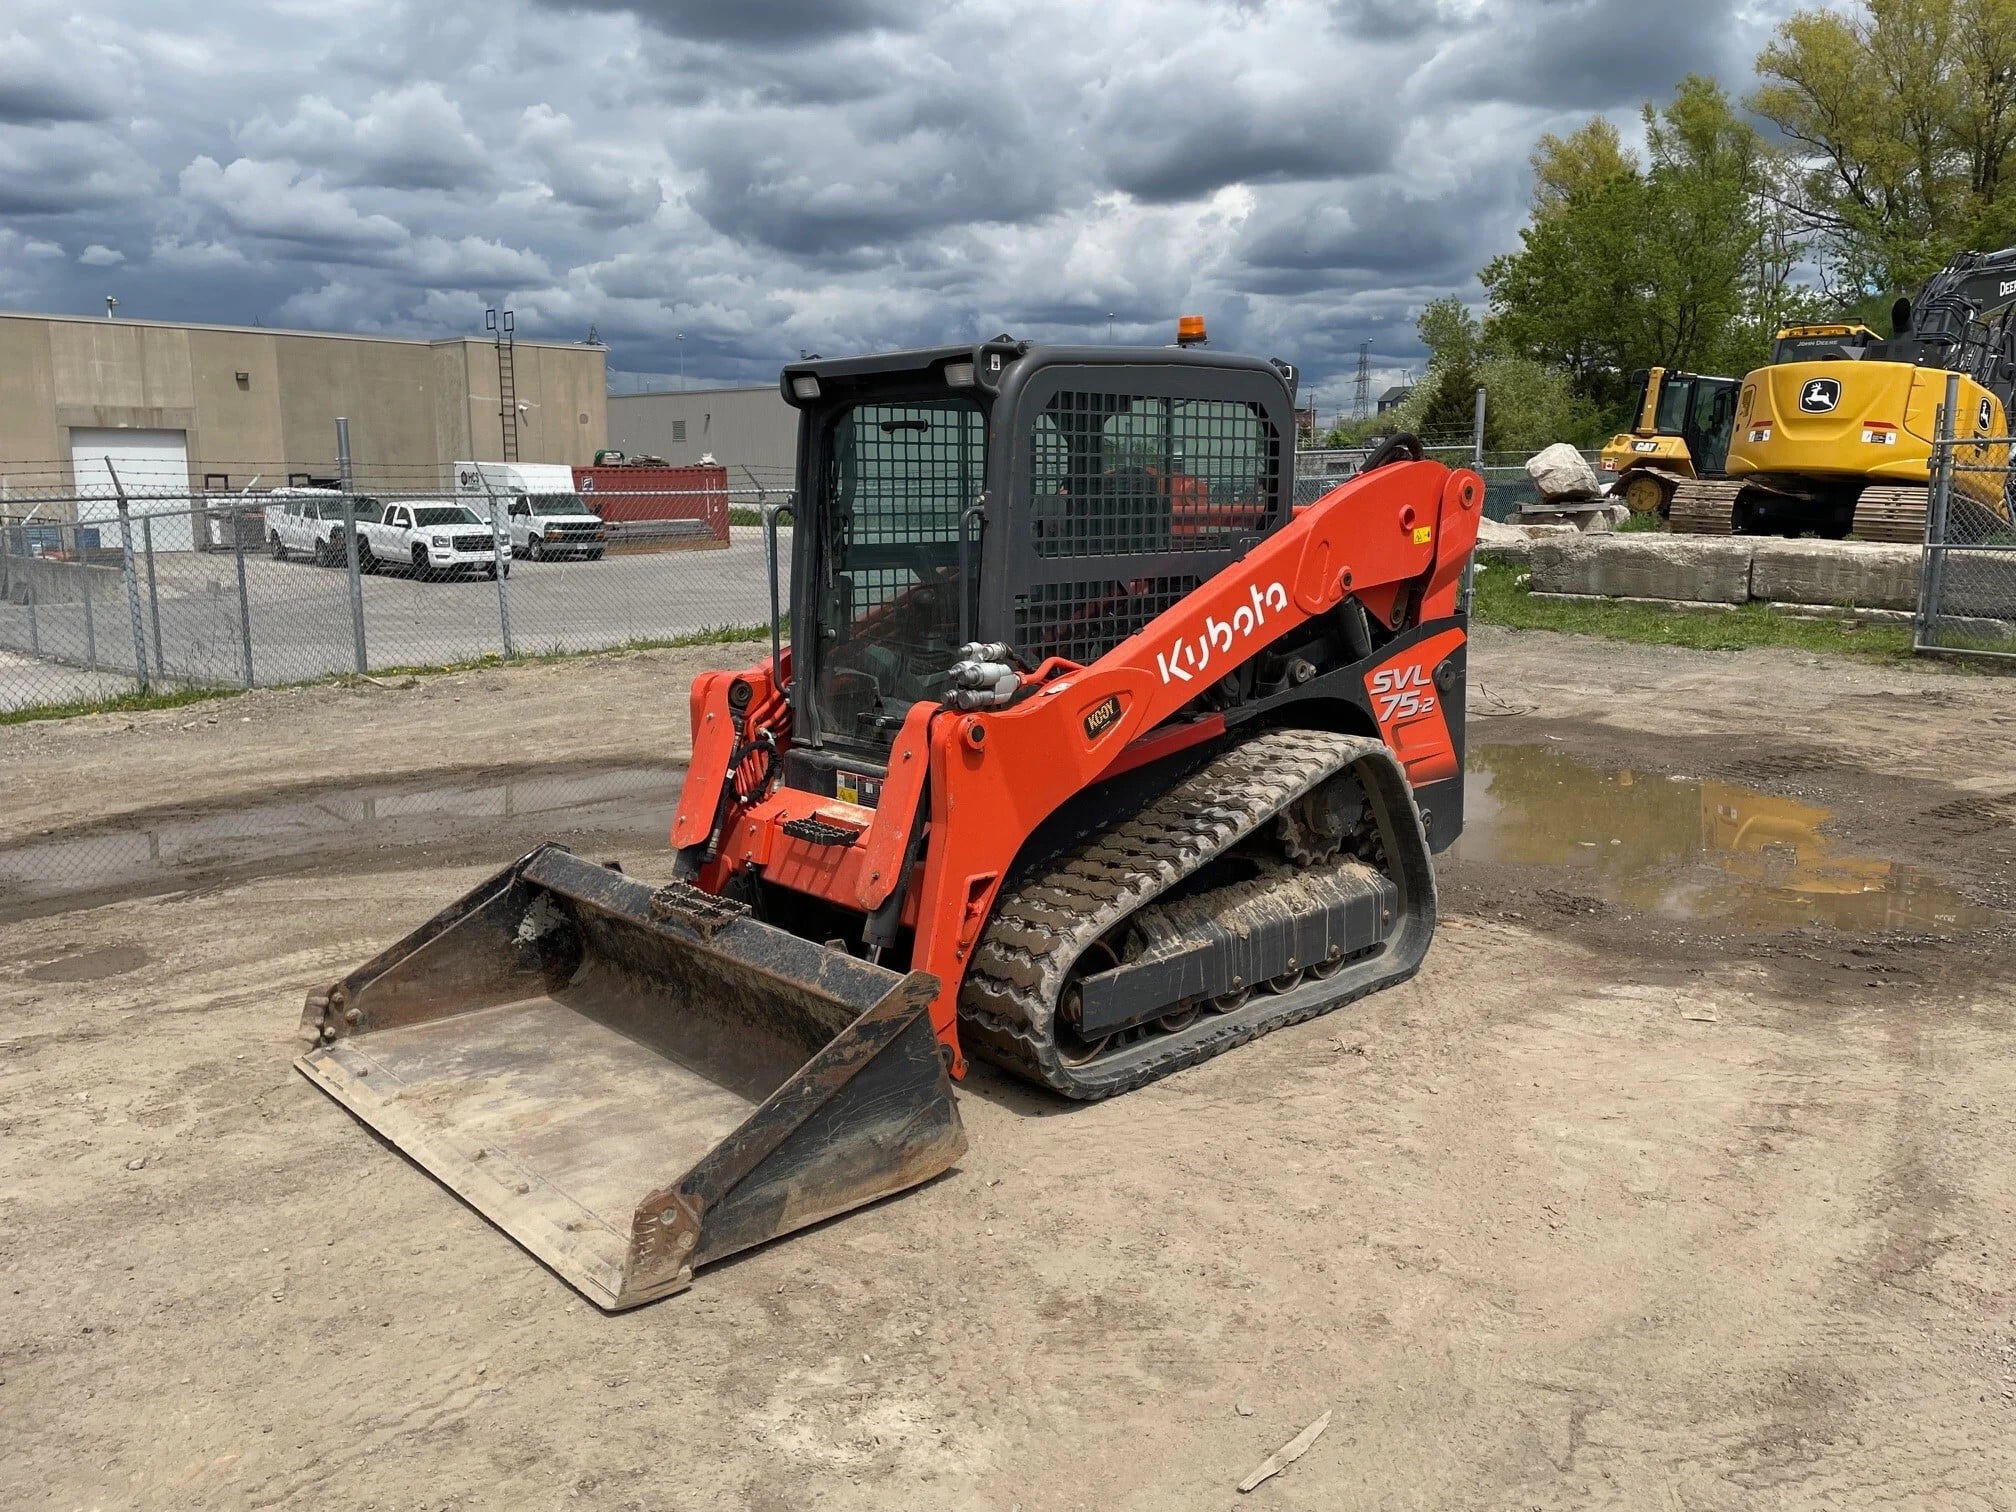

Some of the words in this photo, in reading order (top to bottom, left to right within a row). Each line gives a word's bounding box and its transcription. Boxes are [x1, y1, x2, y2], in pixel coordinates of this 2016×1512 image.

[1635, 442, 1656, 452] CAT
[1156, 582, 1288, 685] Kubota
[1370, 664, 1431, 695] SVL
[1088, 699, 1114, 730] KOOY
